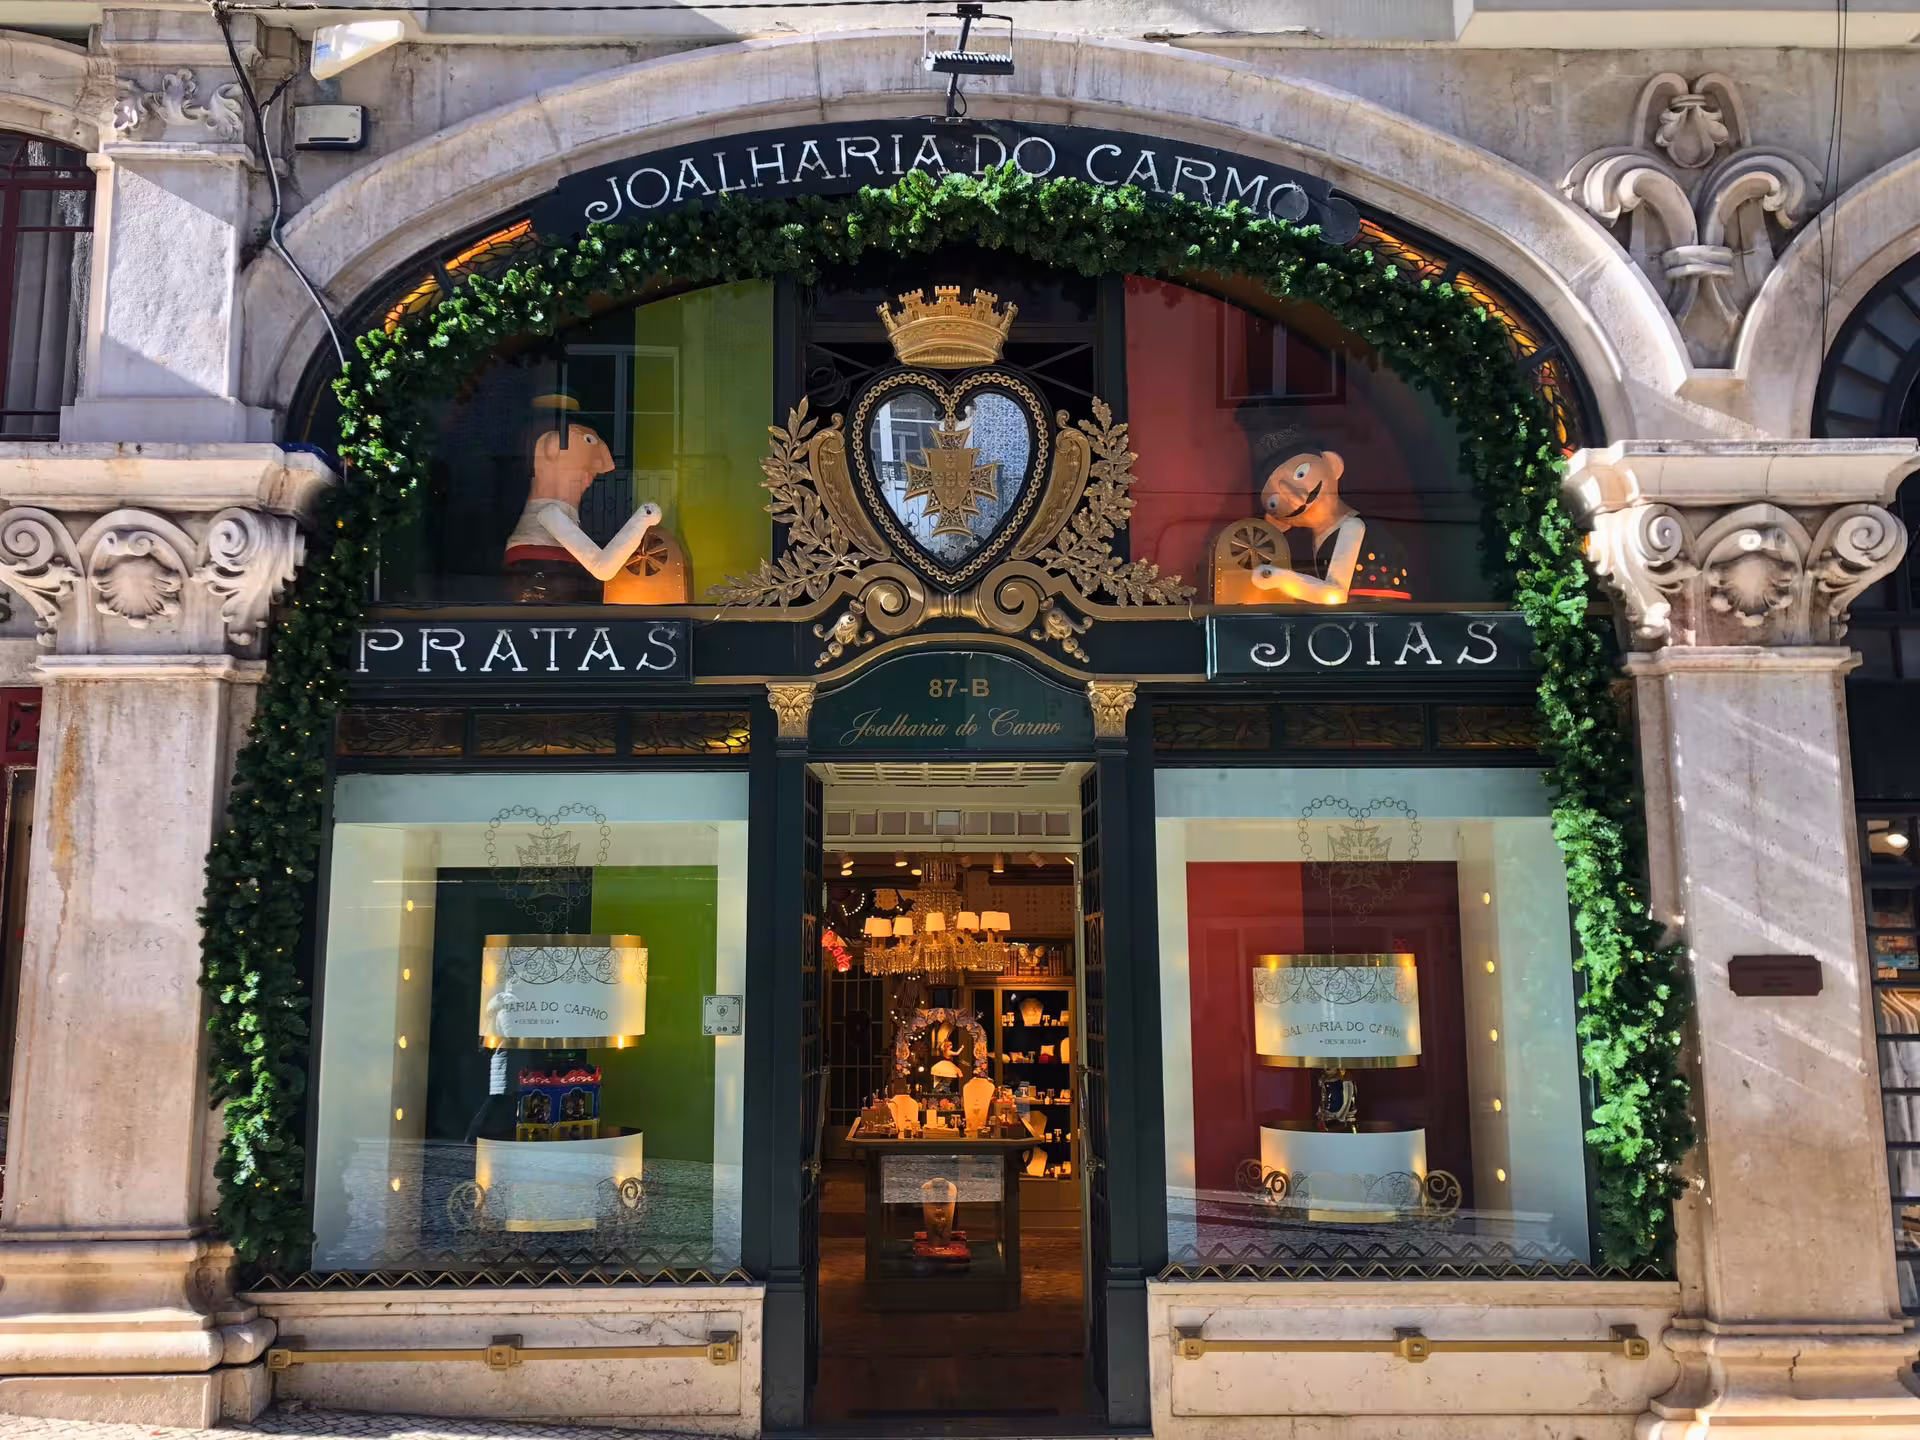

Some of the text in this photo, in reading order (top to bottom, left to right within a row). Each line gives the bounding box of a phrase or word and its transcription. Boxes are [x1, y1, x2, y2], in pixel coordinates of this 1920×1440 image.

[585, 134, 1309, 223] JOALHARIA DO CARMO
[356, 626, 678, 673] PRATAS
[929, 678, 990, 698] 87-B
[839, 707, 1064, 746] Joalharia do Carmo
[541, 1001, 558, 1012] DO
[564, 1003, 608, 1021] CARMO
[1346, 1021, 1364, 1032] DO
